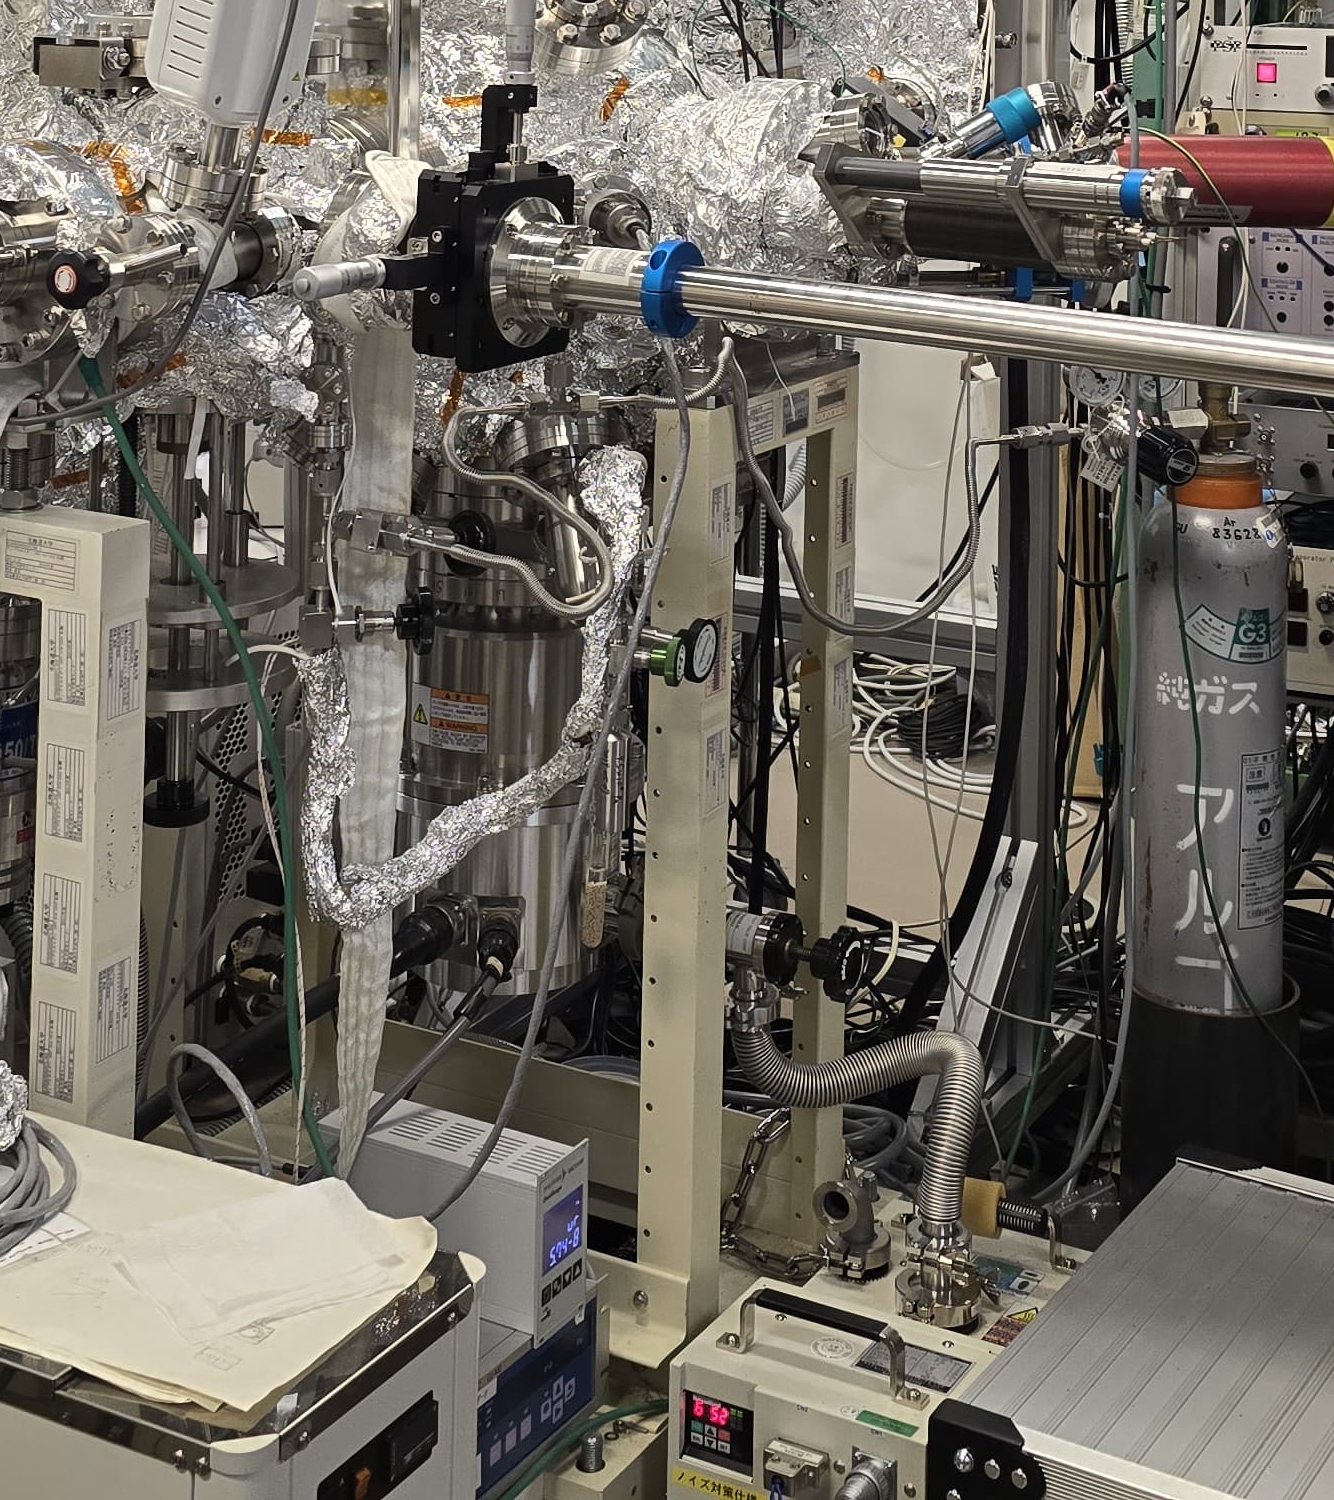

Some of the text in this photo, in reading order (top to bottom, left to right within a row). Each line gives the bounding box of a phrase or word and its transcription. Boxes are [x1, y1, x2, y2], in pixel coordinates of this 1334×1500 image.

[1223, 516, 1237, 527] Ar
[1212, 528, 1262, 541] 83628
[1238, 622, 1267, 643] G3
[1157, 672, 1260, 714] 純ガス
